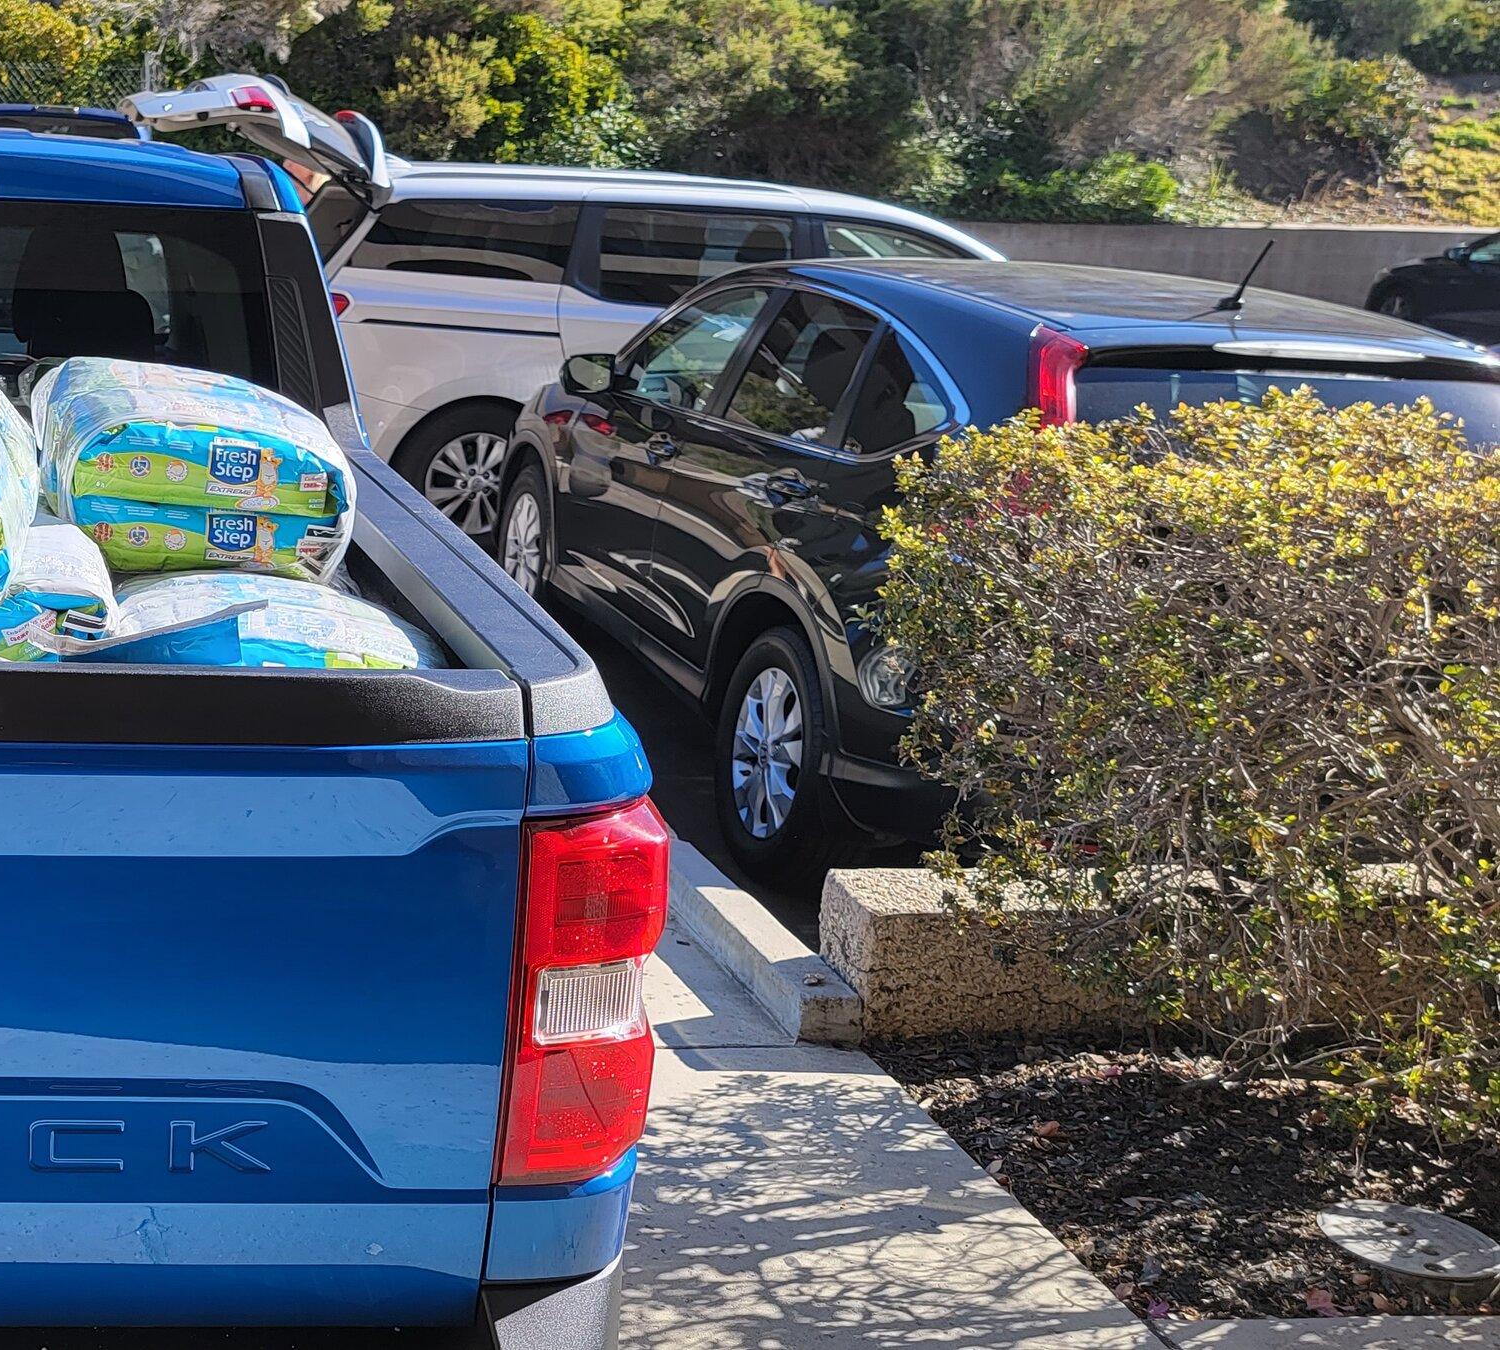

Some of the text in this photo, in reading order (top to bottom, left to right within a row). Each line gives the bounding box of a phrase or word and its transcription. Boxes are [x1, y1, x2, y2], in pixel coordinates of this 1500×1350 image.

[215, 447, 257, 466] Fresh
[215, 461, 254, 482] Step
[208, 484, 254, 496] EXTREME
[212, 517, 254, 532] Fresh
[212, 529, 251, 548] Step
